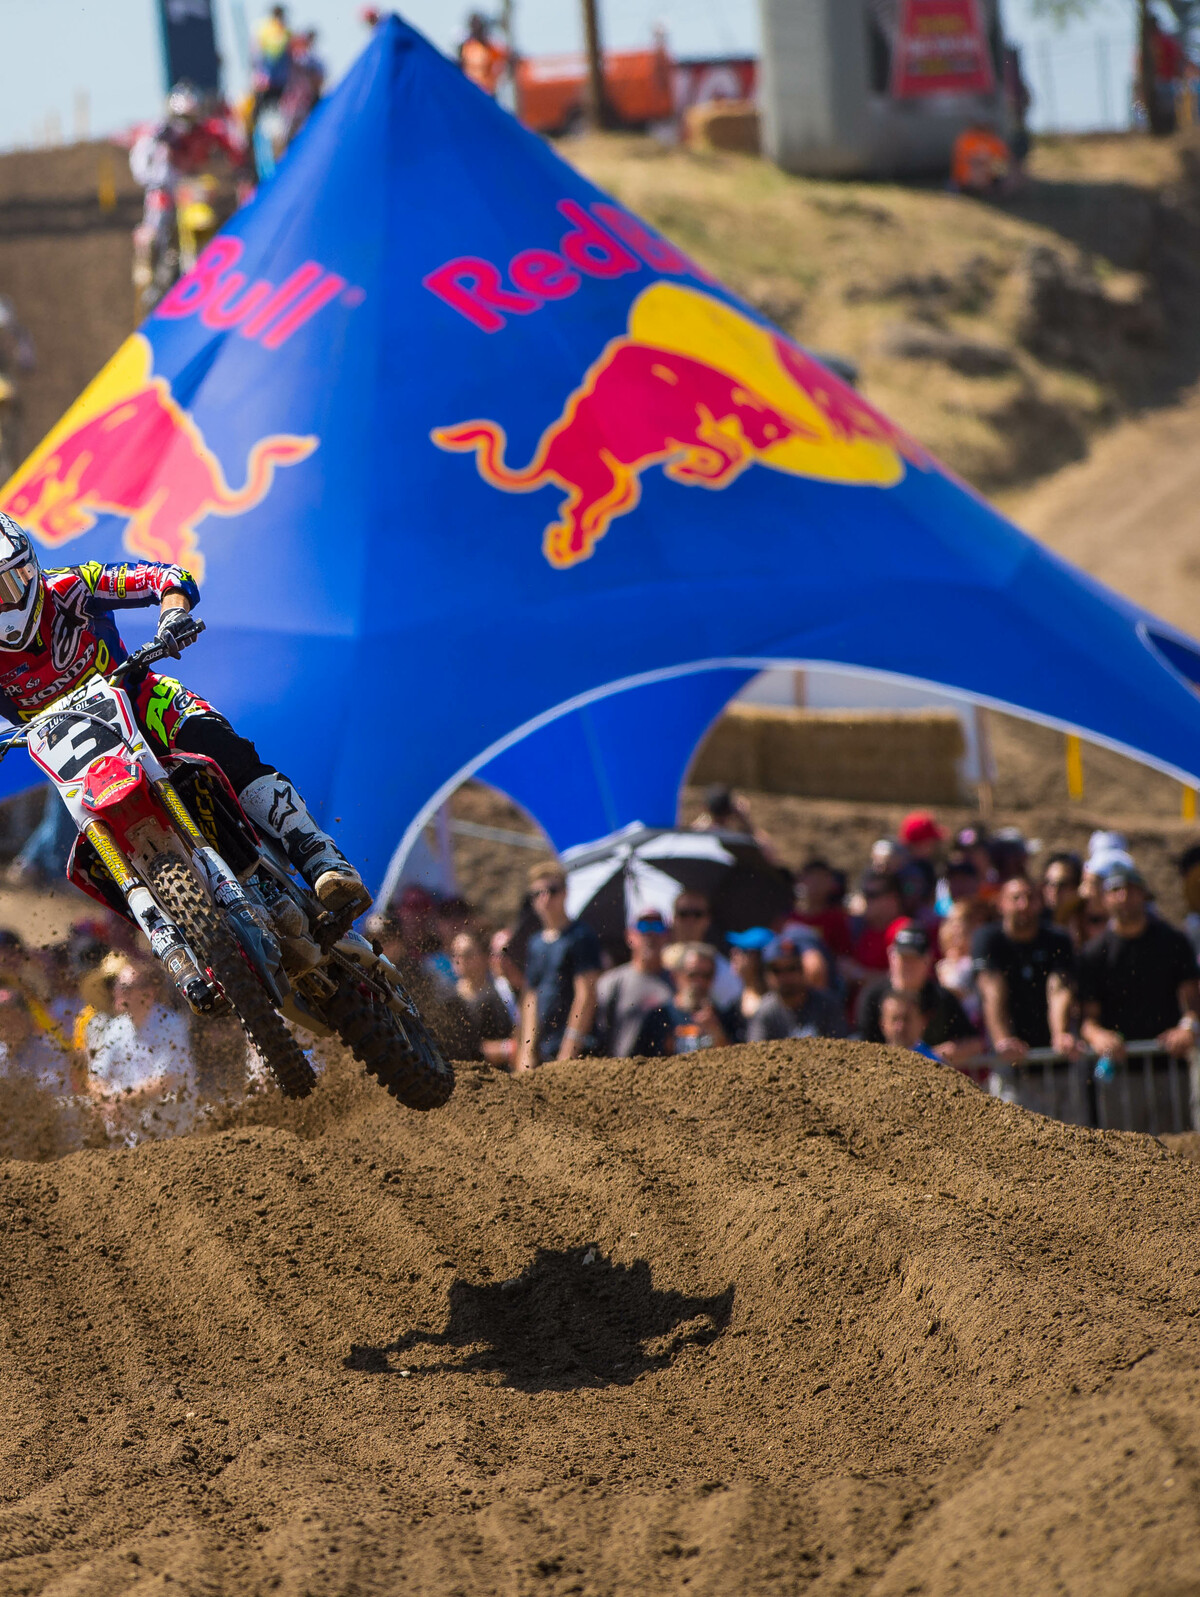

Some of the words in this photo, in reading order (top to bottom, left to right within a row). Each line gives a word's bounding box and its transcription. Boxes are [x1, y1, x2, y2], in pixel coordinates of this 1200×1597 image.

[154, 235, 346, 351] Bull
[17, 642, 95, 707] HONDA
[75, 701, 90, 711] OIL
[46, 698, 124, 781] 3
[215, 881, 245, 901] MUSCL
